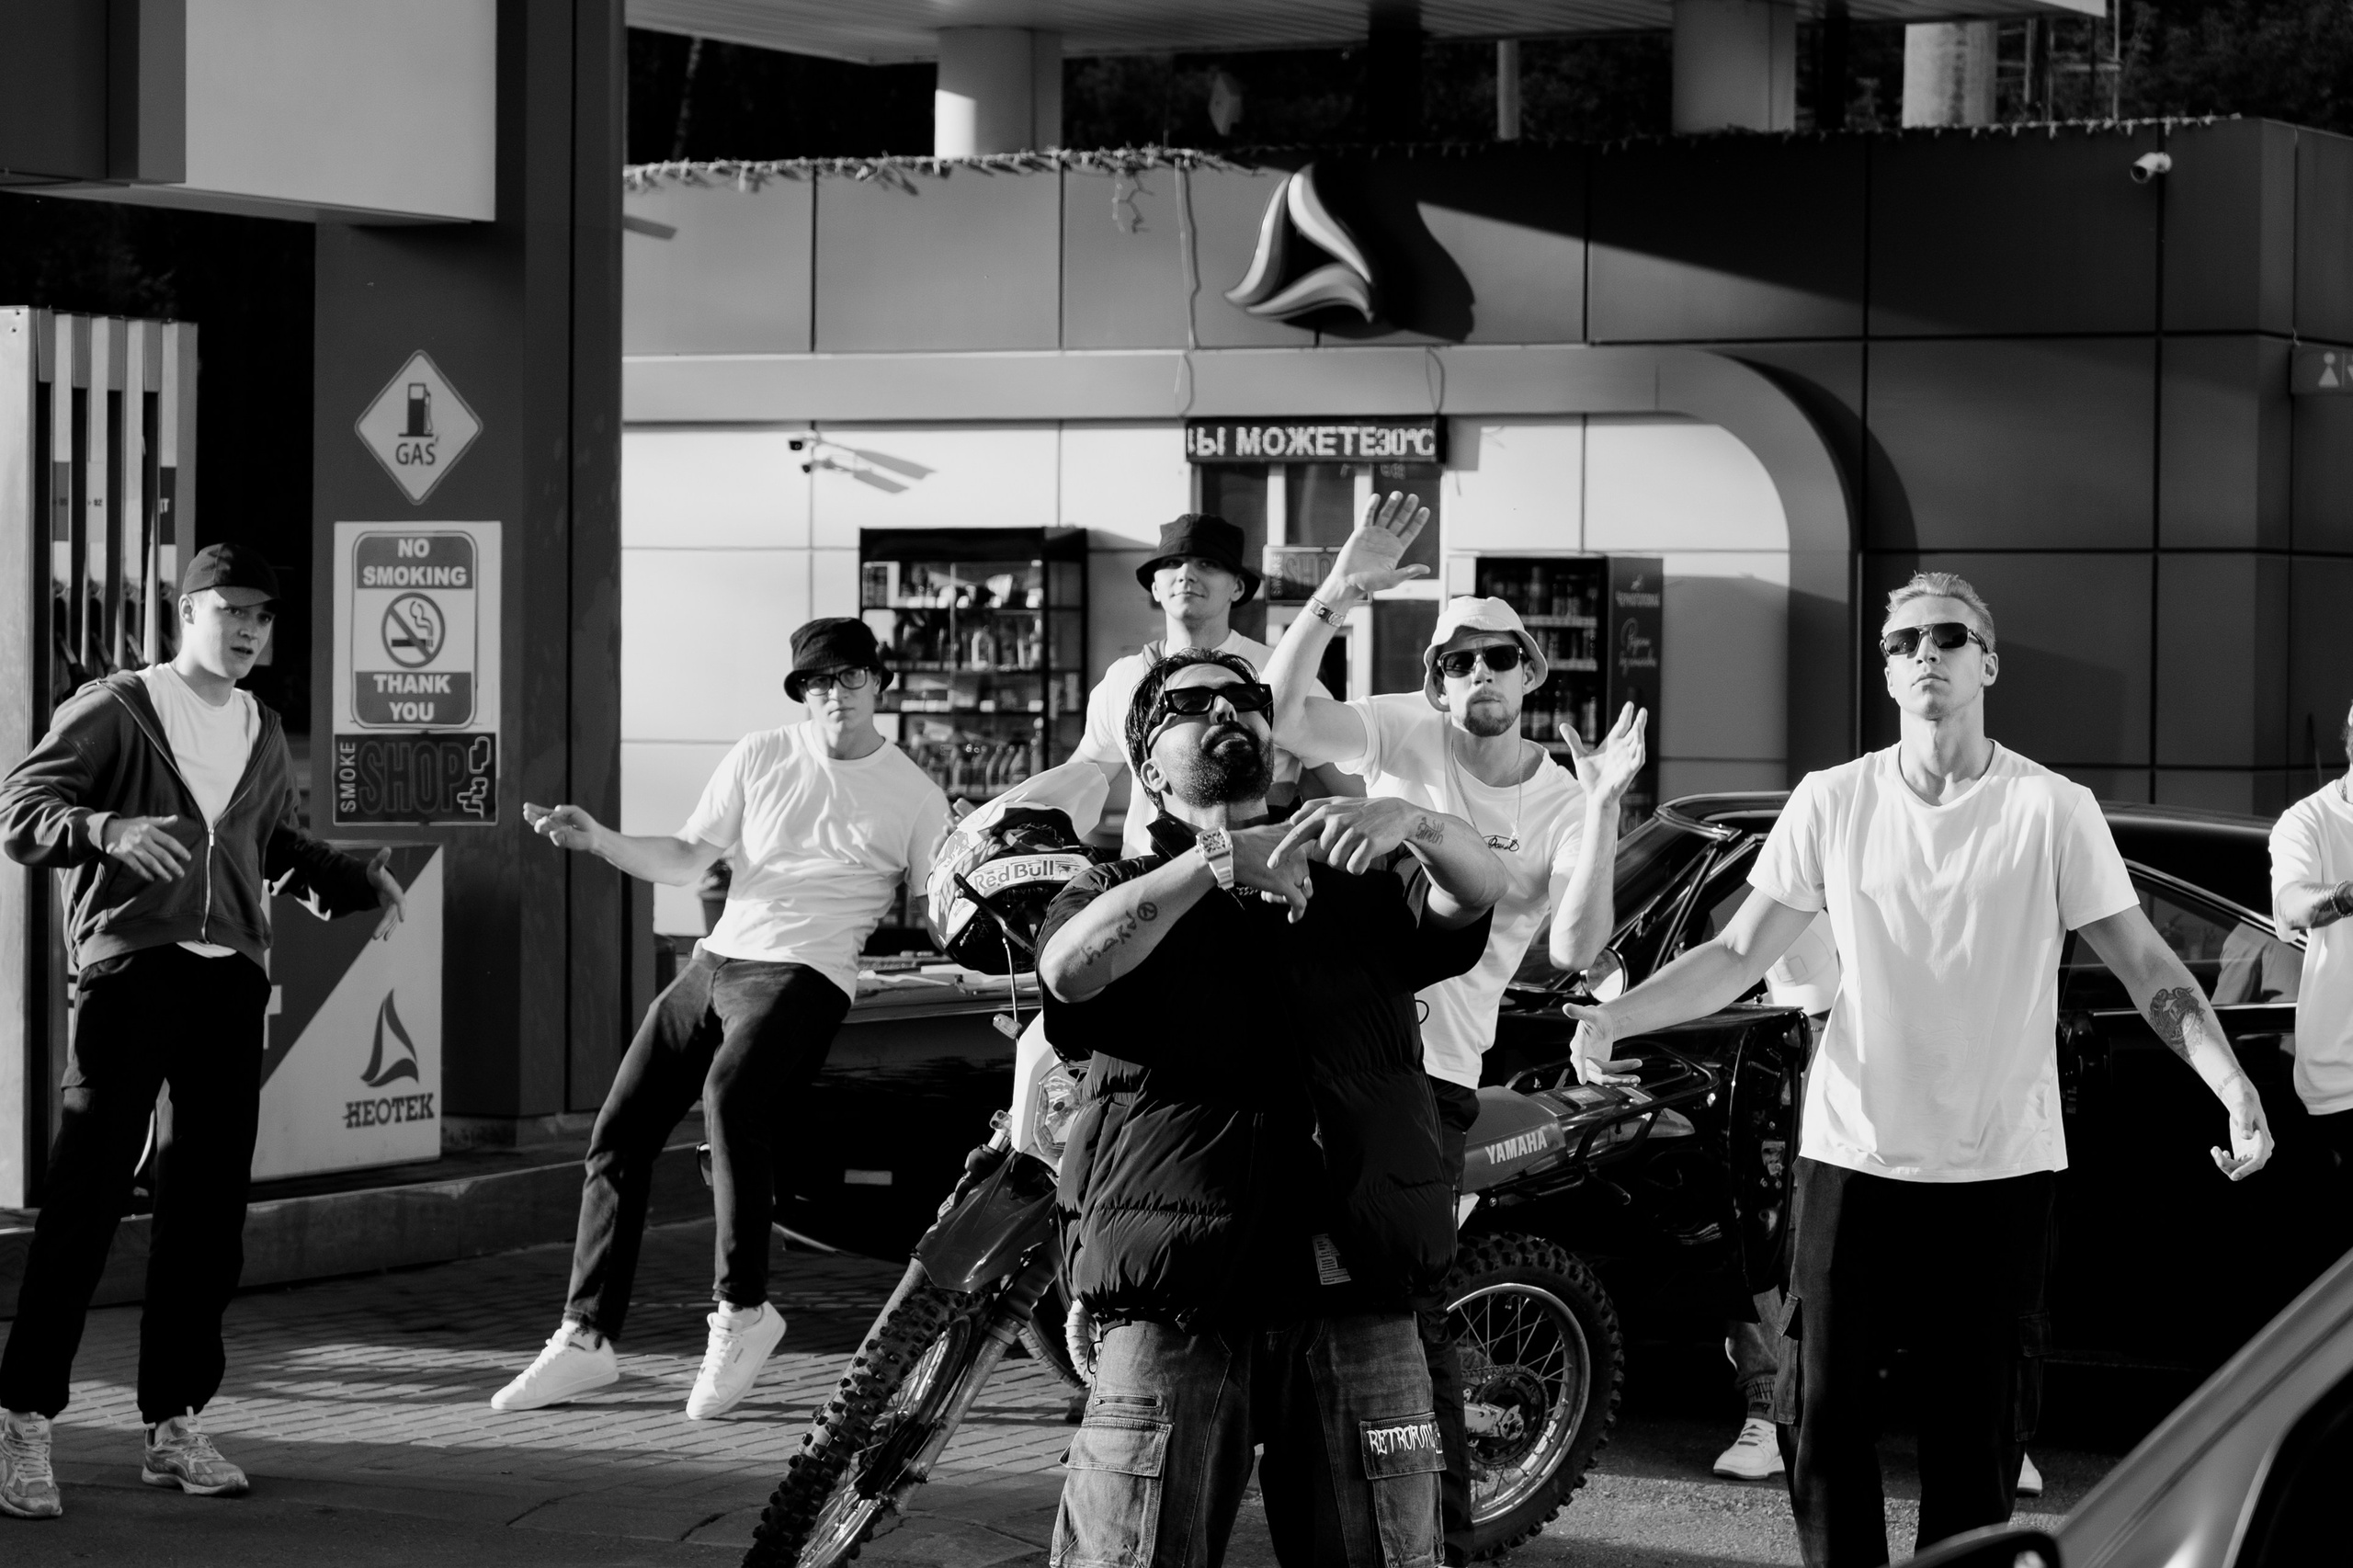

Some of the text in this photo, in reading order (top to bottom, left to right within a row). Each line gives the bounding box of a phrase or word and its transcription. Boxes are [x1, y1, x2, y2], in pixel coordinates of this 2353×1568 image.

[395, 442, 436, 466] GAS
[1236, 426, 1376, 457] МОЖЕТЕ
[397, 539, 430, 559] NO
[362, 565, 468, 587] SMOKING
[373, 674, 451, 695] THANK
[390, 701, 435, 722] YOU
[339, 742, 357, 813] SMOKE
[358, 741, 468, 815] SHOP
[974, 859, 1054, 892] Red Bull
[1484, 1130, 1549, 1165] YAMAHA
